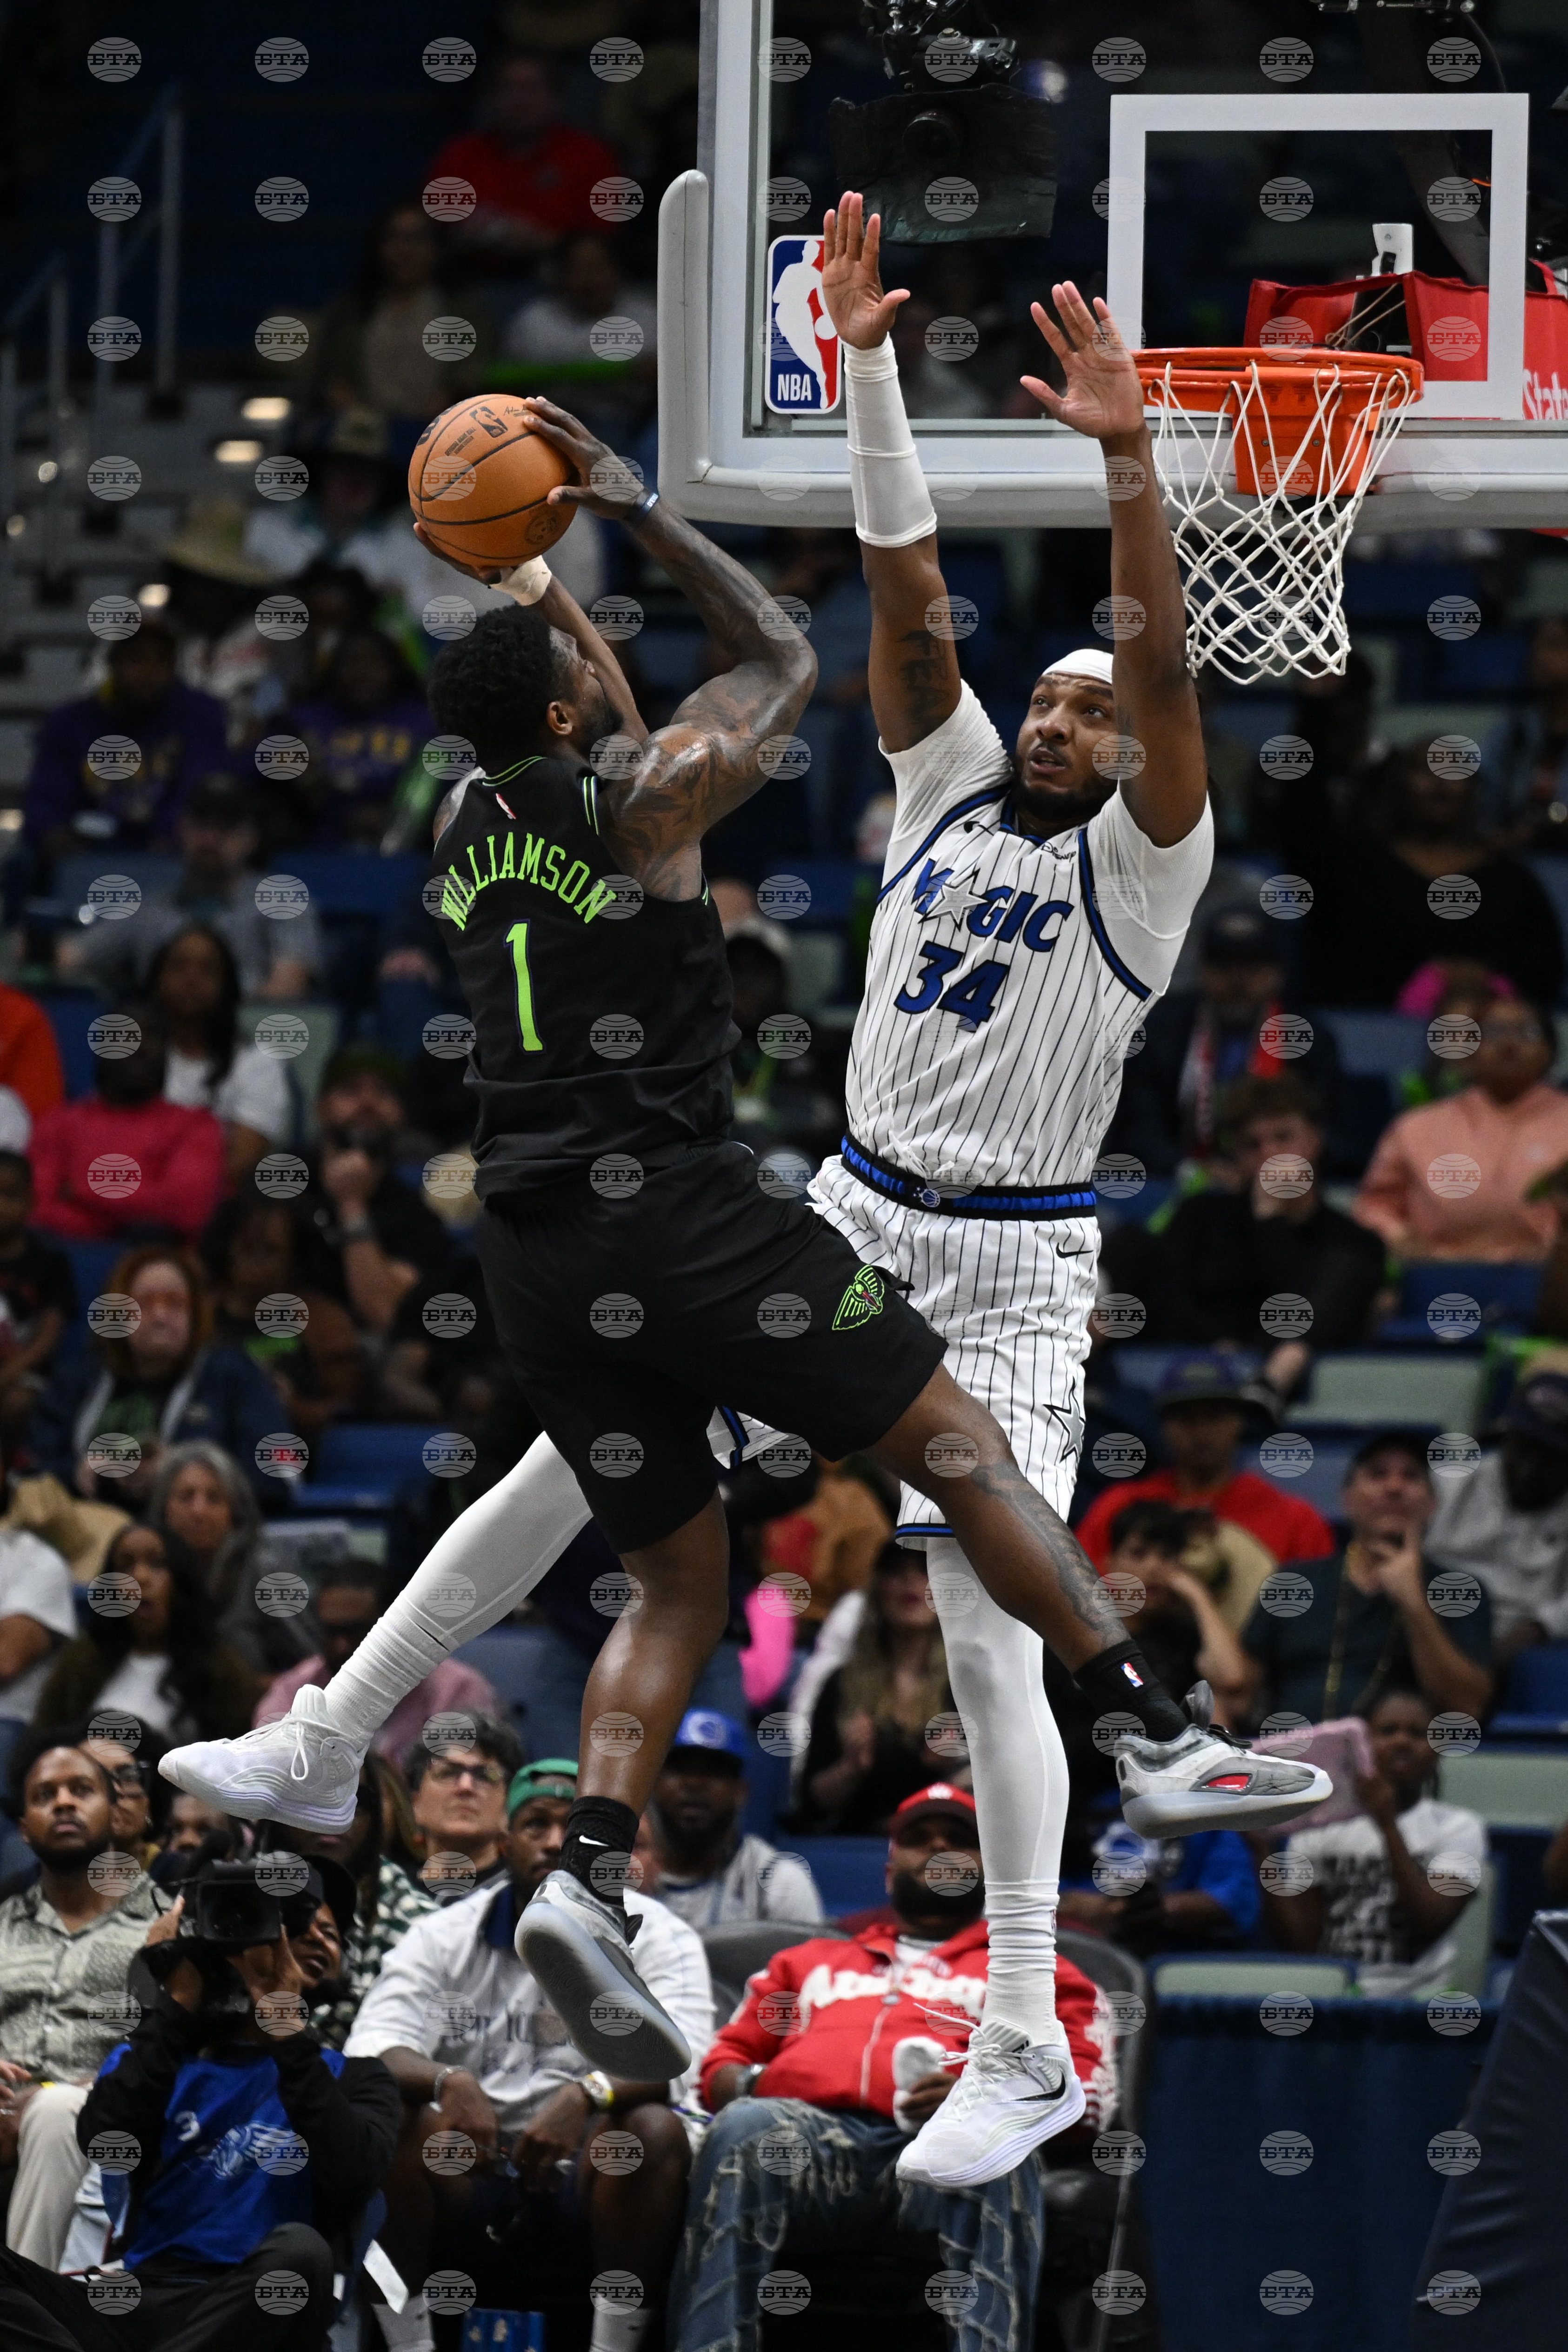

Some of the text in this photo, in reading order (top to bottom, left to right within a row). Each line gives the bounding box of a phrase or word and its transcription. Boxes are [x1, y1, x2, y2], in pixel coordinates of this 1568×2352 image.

[777, 374, 812, 401] NBA
[441, 832, 617, 931] WILLIAMSON
[504, 920, 545, 1053] 1
[894, 940, 1011, 1033] 34
